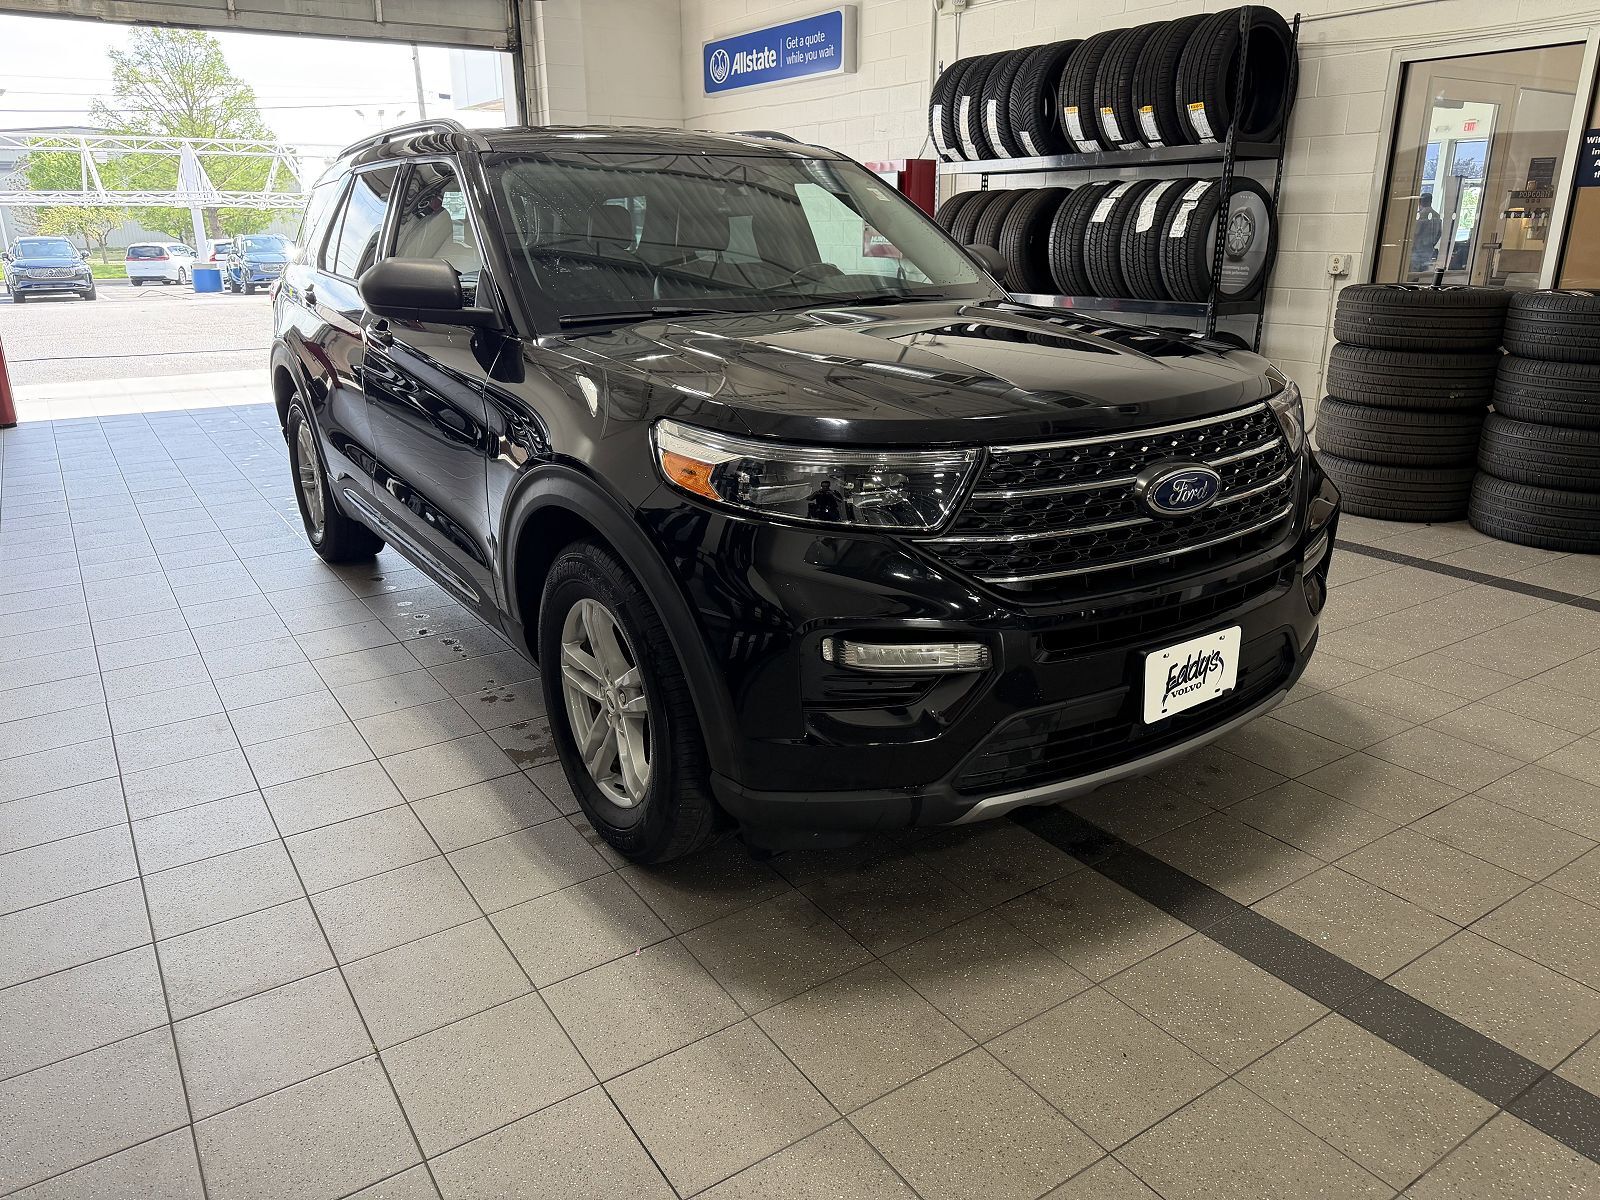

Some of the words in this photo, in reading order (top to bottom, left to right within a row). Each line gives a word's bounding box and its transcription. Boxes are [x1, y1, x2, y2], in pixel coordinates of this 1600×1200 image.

[786, 36, 799, 50] Get
[800, 37, 804, 47] a
[805, 30, 825, 47] quote
[731, 46, 776, 75] Allstate
[785, 50, 804, 65] while
[804, 50, 818, 64] you
[818, 44, 834, 59] wait
[1464, 121, 1477, 131] EXIT
[1168, 477, 1208, 506] Ford
[1163, 649, 1224, 702] Eddy's
[1171, 682, 1202, 698] VOLVO
